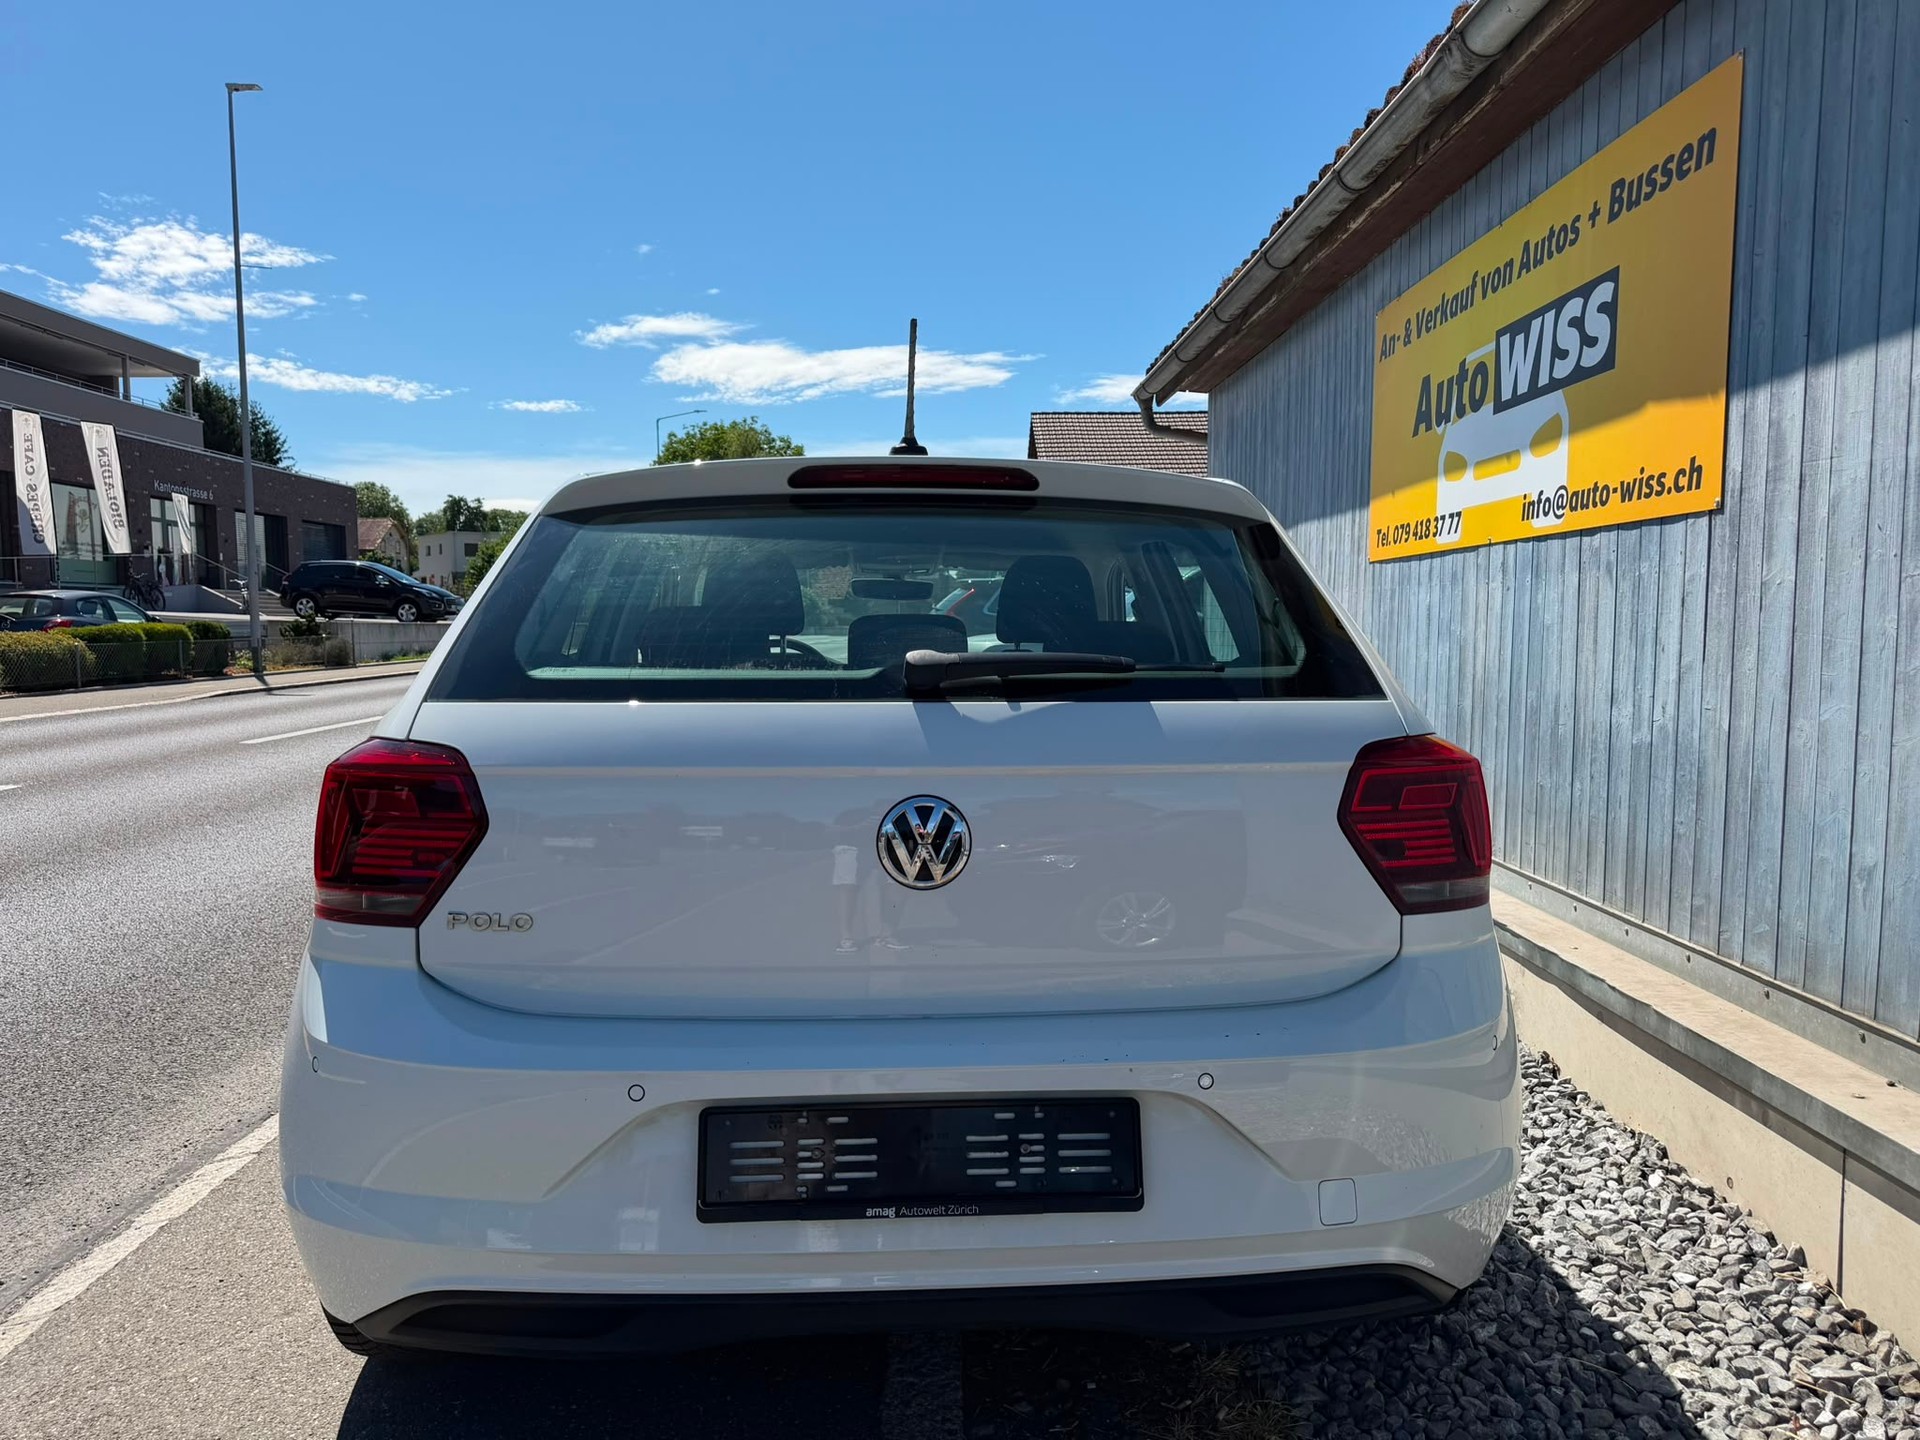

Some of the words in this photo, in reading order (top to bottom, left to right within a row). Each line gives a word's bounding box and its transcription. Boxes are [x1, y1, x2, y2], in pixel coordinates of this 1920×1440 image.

[1379, 333, 1401, 363] An-
[1403, 318, 1412, 348] &
[1416, 270, 1479, 340] Verkauf
[1481, 257, 1515, 301] von
[1516, 213, 1581, 280] Autos
[1588, 200, 1601, 229] +
[1607, 127, 1717, 225] Bussen
[153, 479, 208, 500] Kantonsstrasse
[208, 489, 214, 501] 6
[1521, 455, 1704, 522] info@auto-wiss.ch
[1376, 525, 1391, 548] Tel.
[1393, 522, 1411, 546] 079
[1412, 518, 1431, 541] 418
[1433, 514, 1446, 538] 37
[1447, 511, 1462, 535] 77
[447, 911, 534, 932] POLO
[865, 1206, 896, 1219] amag
[899, 1205, 946, 1216] Autowelt
[947, 1203, 979, 1215] Zürich
